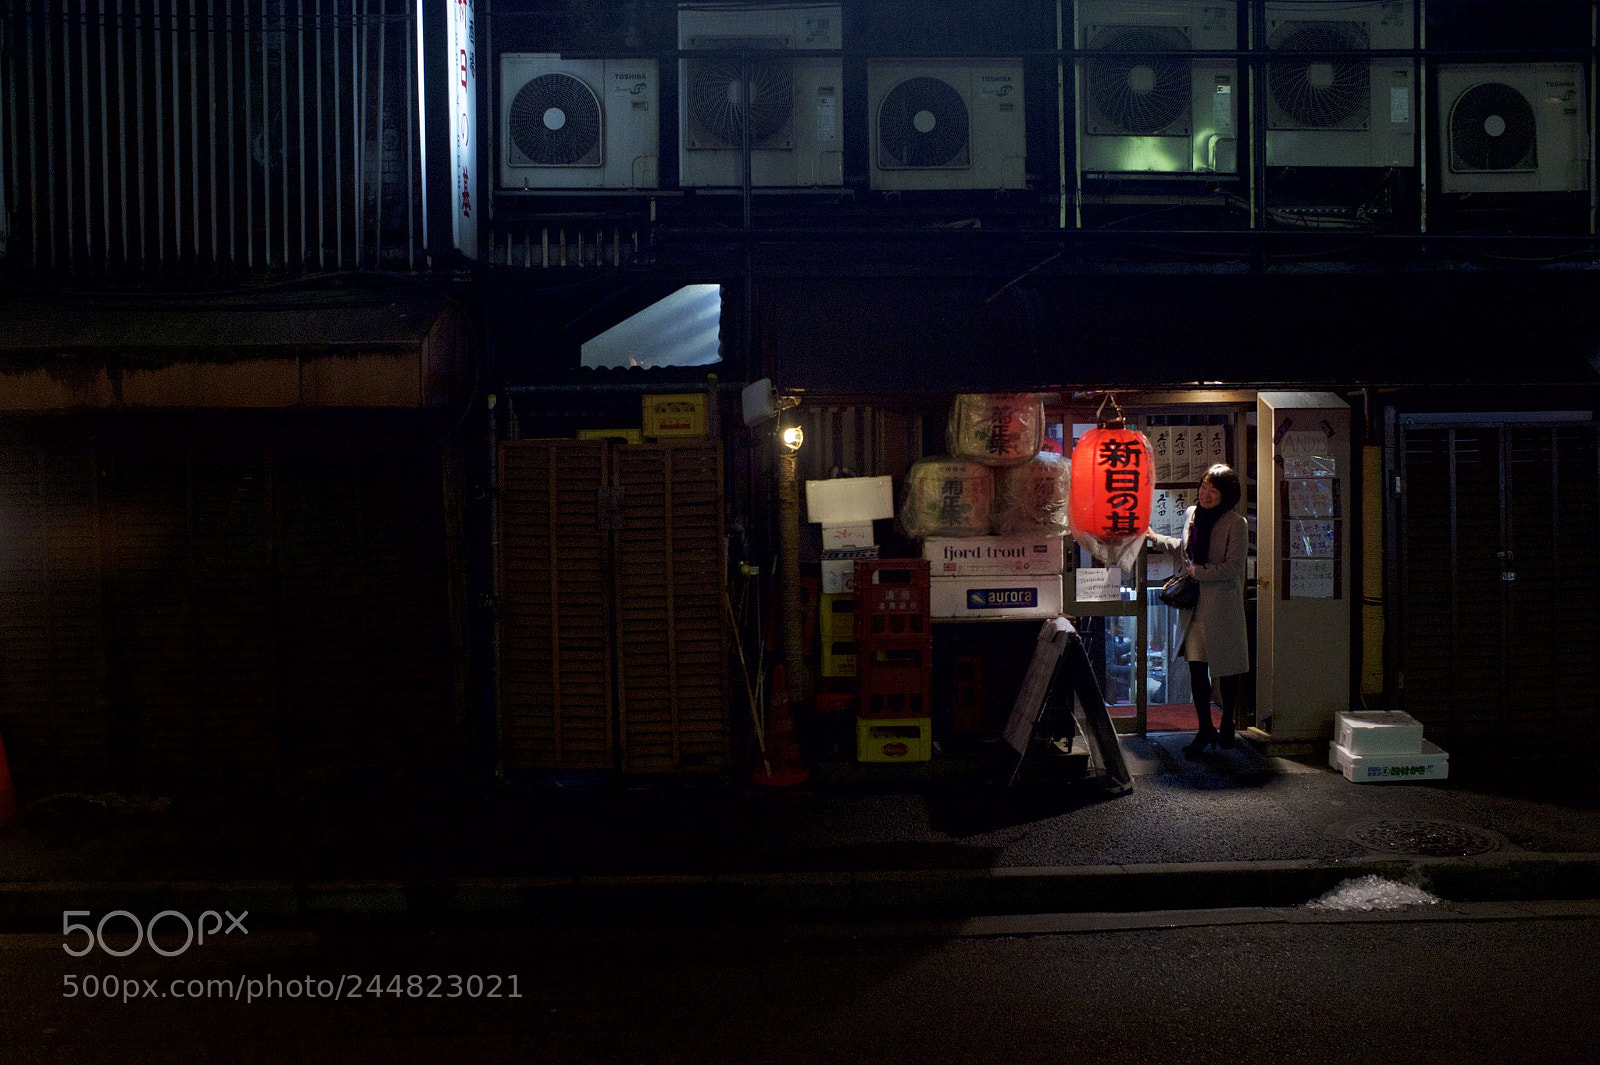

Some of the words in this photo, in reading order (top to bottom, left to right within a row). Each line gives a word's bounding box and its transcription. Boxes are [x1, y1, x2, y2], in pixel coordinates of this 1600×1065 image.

[943, 545, 981, 561] fjord
[986, 546, 1026, 559] trout
[988, 591, 1032, 603] aurora
